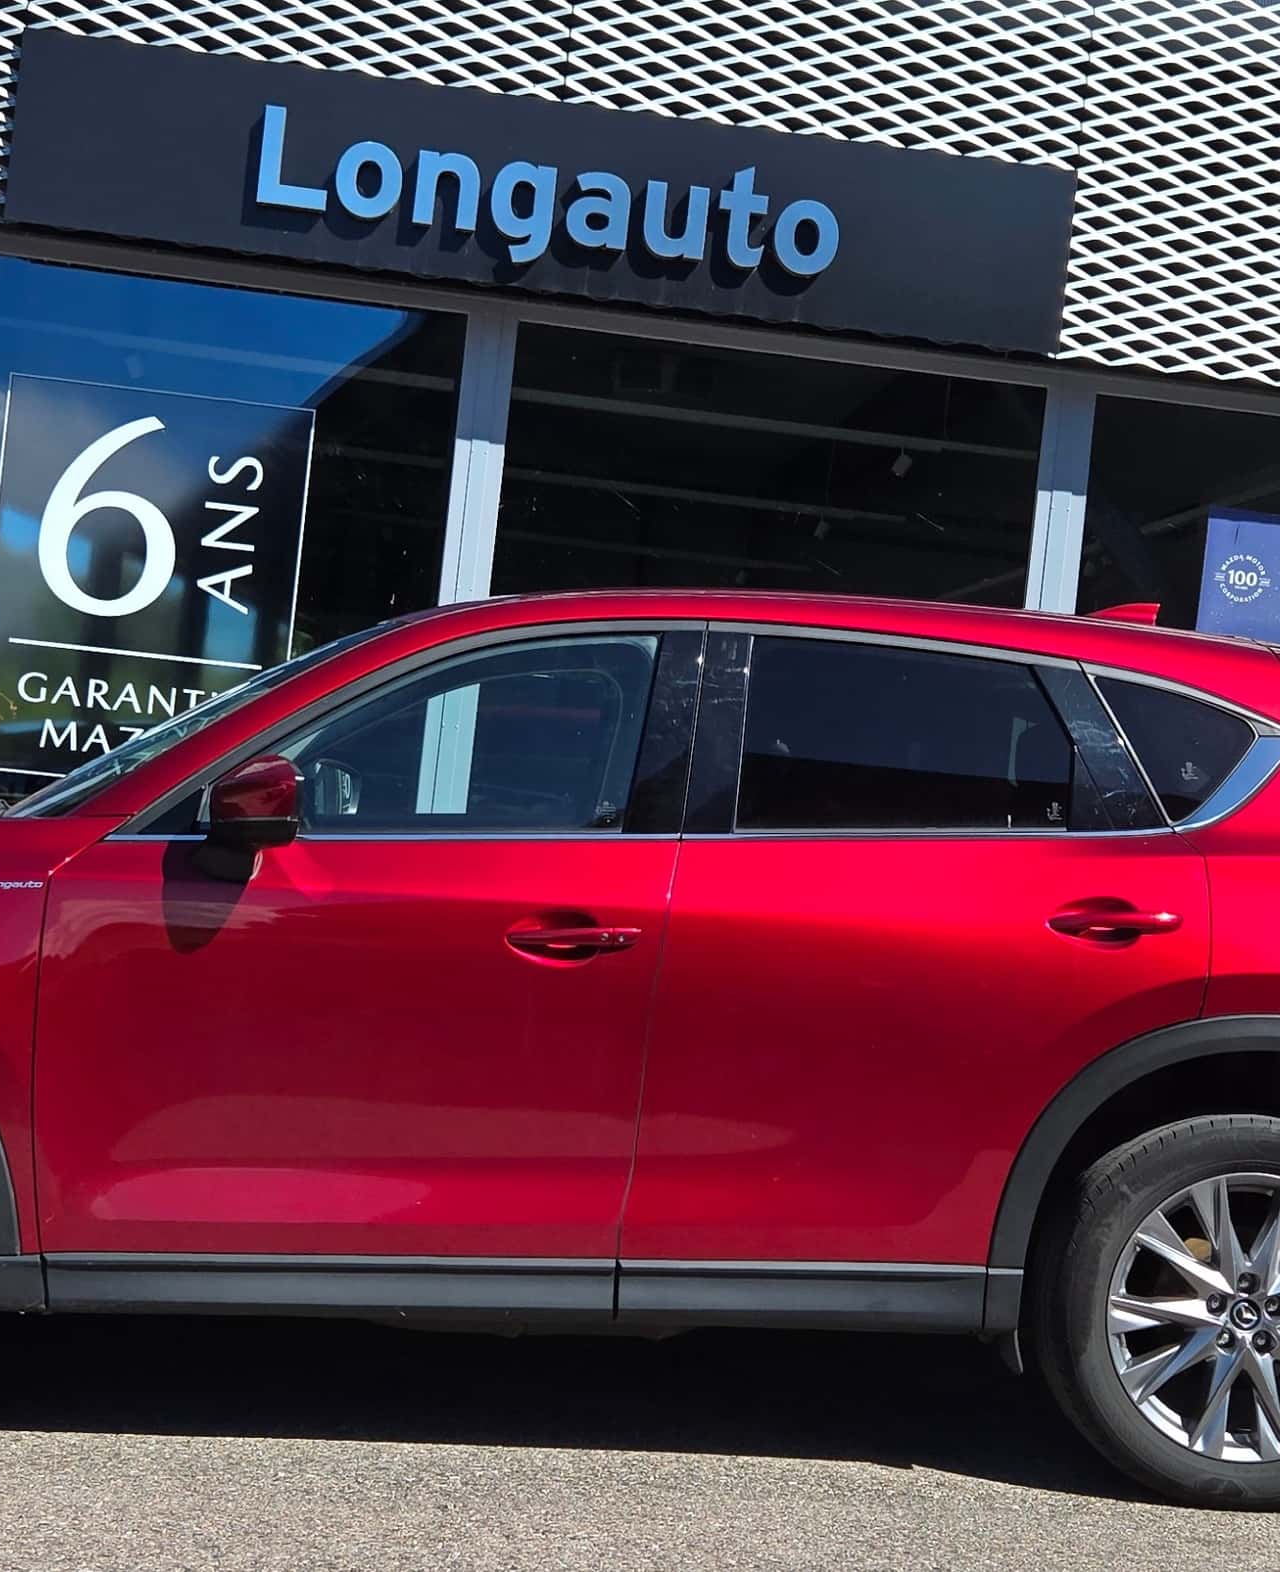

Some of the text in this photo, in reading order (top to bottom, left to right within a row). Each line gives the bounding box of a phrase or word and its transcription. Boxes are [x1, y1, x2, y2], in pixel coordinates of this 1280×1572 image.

[255, 103, 840, 278] Longauto
[38, 416, 177, 617] 6
[196, 455, 265, 616] ANS
[1227, 569, 1259, 587] 100
[17, 671, 218, 717] GARANT
